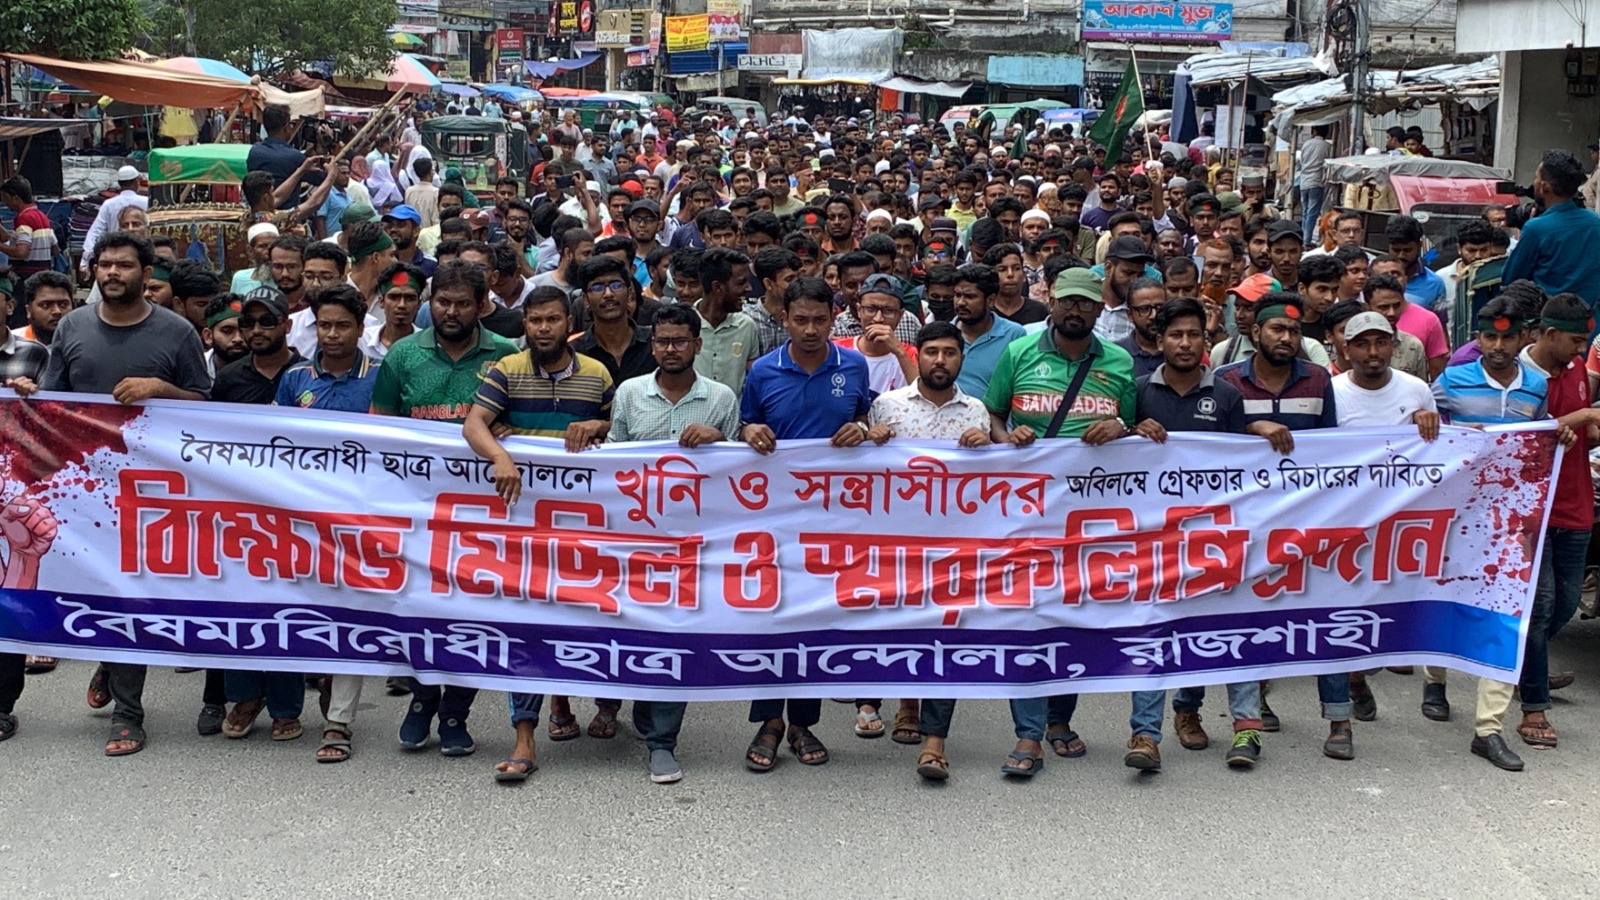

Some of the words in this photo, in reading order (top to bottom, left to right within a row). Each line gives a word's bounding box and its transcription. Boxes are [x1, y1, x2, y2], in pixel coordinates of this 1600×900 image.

[1102, 3, 1175, 18] আকাশ
[1179, 4, 1215, 25] সুজ
[411, 403, 473, 419] BANGLAD
[1022, 394, 1118, 416] BANGADESH
[181, 430, 370, 474] বৈষম্যবিরোধী
[379, 449, 436, 481] ছাত্র
[615, 455, 711, 528] খুনি
[728, 470, 769, 511] ও
[789, 455, 1056, 518] সন্ত্রাসীদের
[1065, 466, 1148, 499] অবিলম্বে
[1158, 465, 1246, 499] গ্রেফতার
[1252, 469, 1271, 491] ও
[1277, 458, 1362, 492] বিচারের
[1368, 454, 1446, 489] দাবিতে
[115, 468, 412, 594] বিক্ষোভ
[426, 492, 704, 615] মিছিল
[55, 596, 526, 669] বৈষম্যবিরোধী
[543, 637, 695, 681] ছাত্র
[710, 639, 1086, 679] আন্দোলন,
[1113, 609, 1396, 668] রাজশাহী
